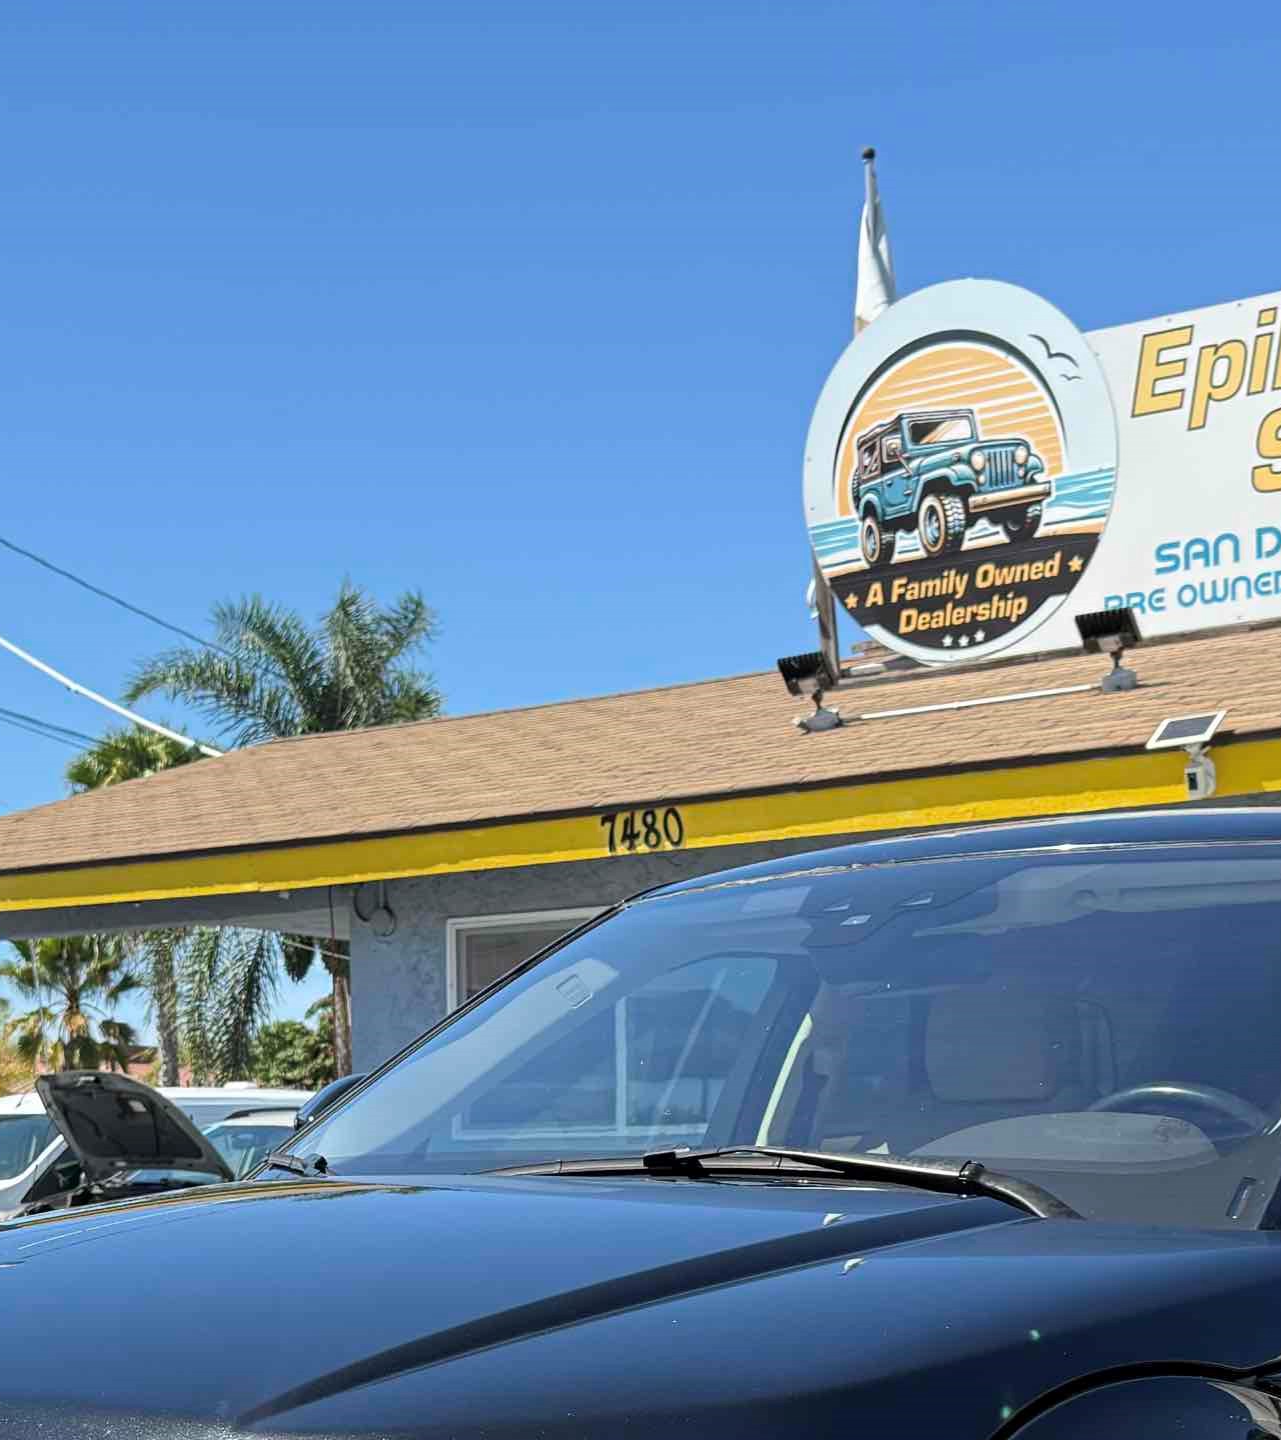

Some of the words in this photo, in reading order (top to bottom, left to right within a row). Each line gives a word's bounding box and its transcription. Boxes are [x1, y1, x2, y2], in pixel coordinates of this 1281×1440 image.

[1154, 532, 1241, 575] SAN
[865, 581, 884, 607] A
[891, 568, 969, 604] Family
[975, 551, 1062, 589] Owned
[1104, 587, 1166, 615] PRE
[899, 591, 1028, 635] Dealership
[600, 807, 684, 853] 7480
